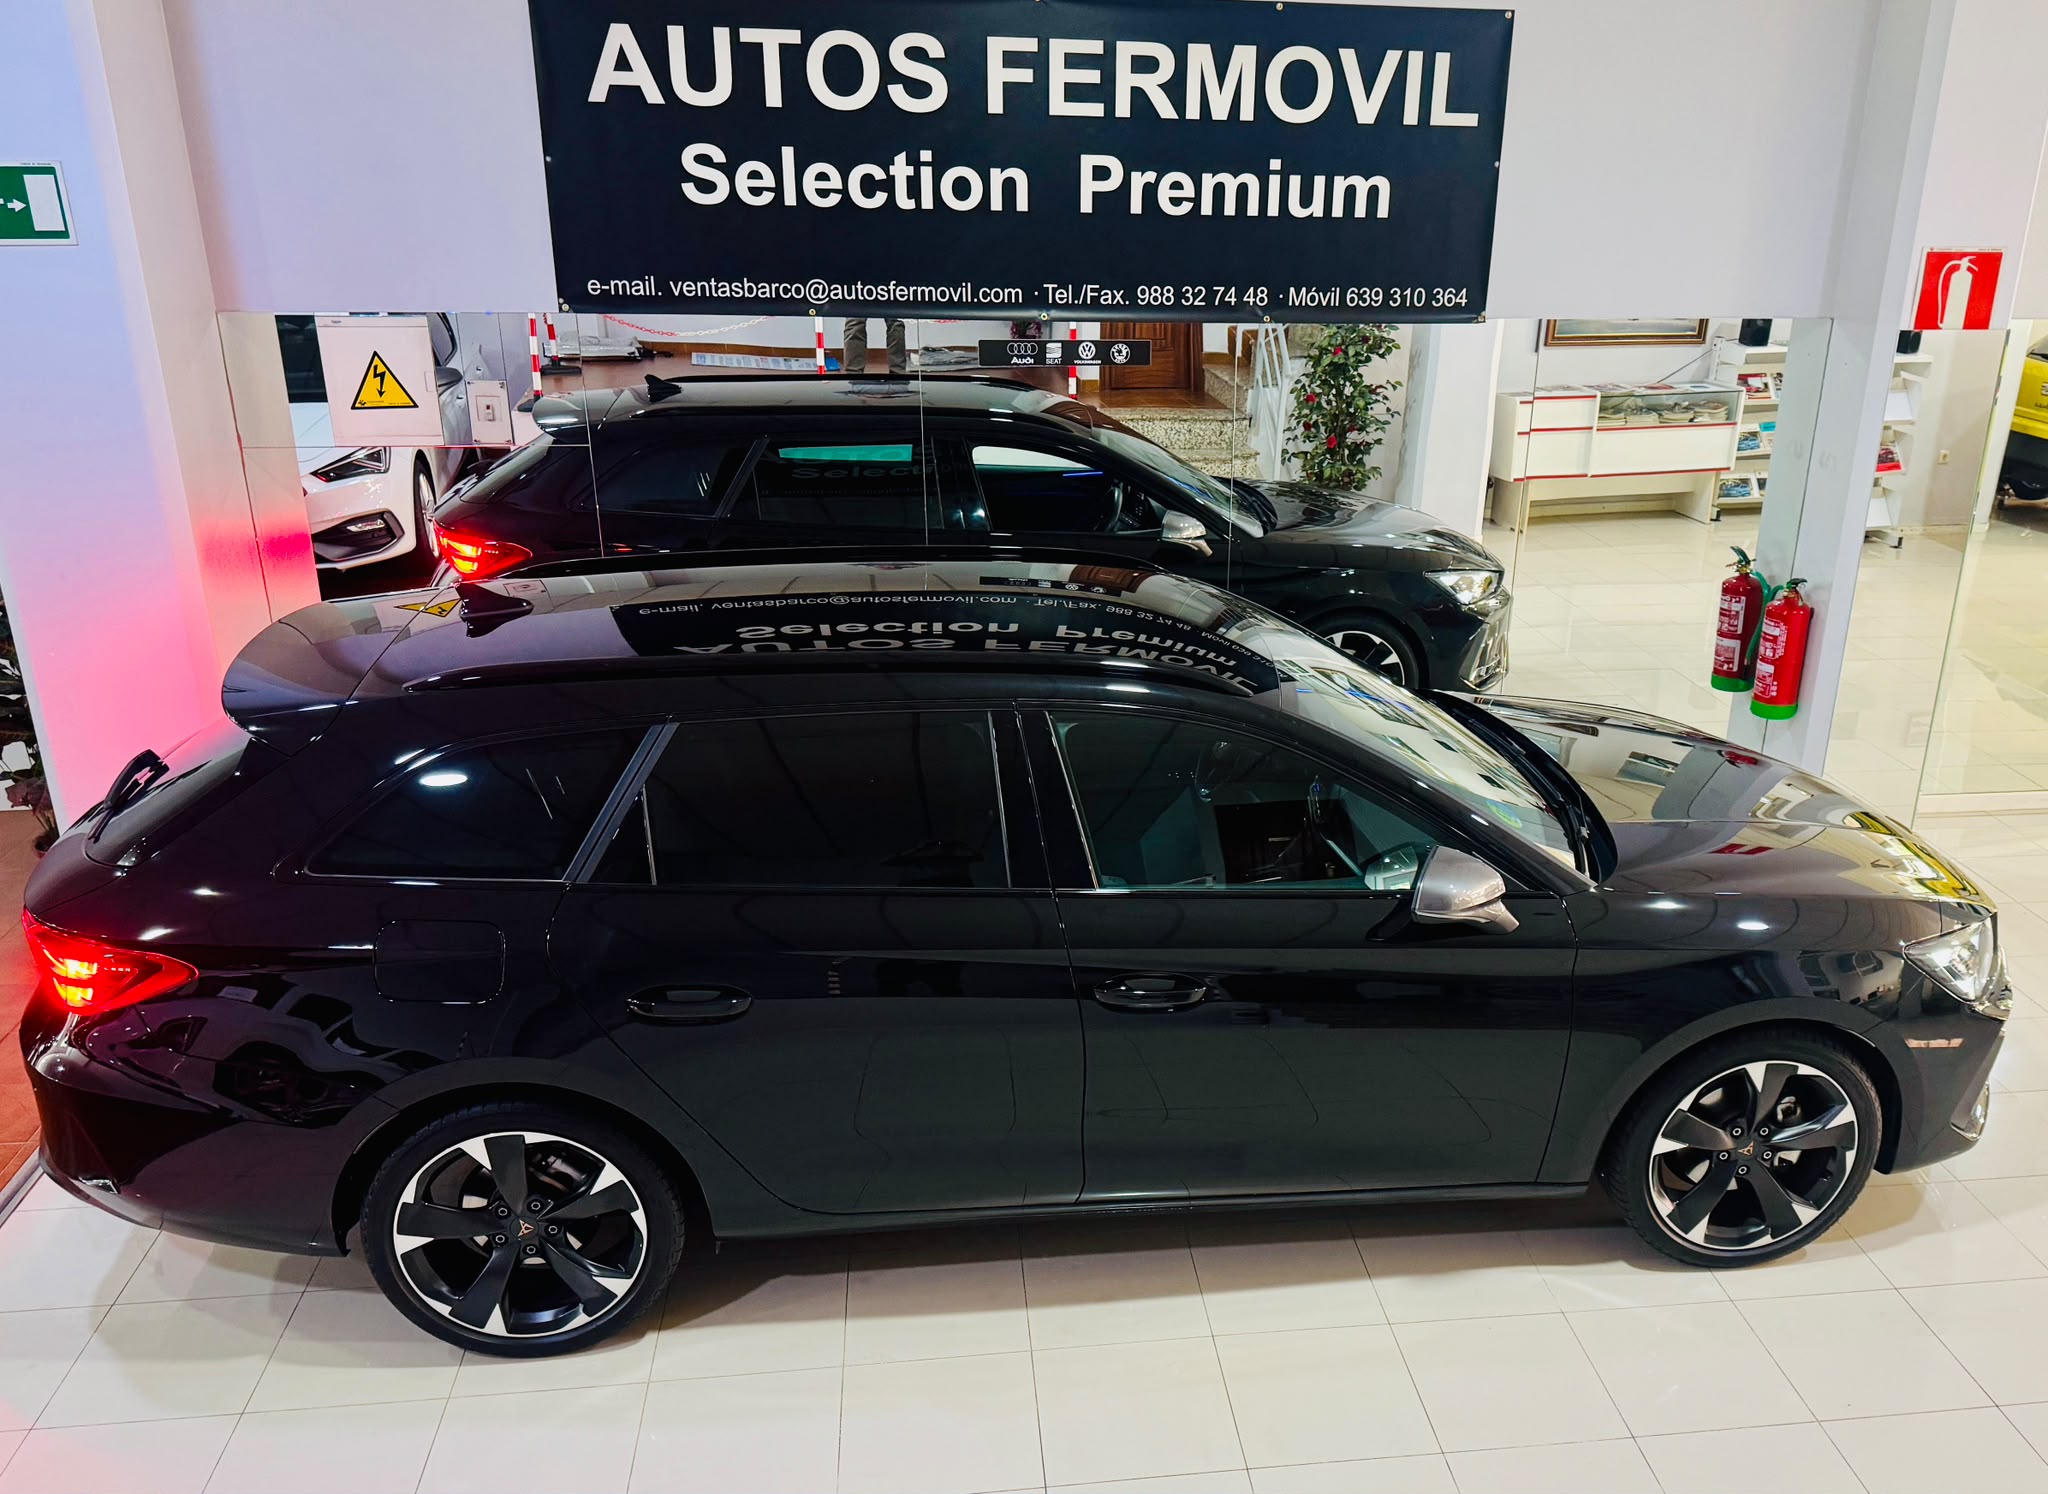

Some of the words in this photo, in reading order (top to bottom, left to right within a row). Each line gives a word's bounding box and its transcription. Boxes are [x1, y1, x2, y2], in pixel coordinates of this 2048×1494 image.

[588, 22, 949, 114] AUTOS
[986, 35, 1480, 128] FERMOVIL
[680, 142, 1030, 212] Selection
[1079, 154, 1391, 219] Premium
[587, 275, 662, 296] e-mail.
[669, 278, 1023, 306] ventasbarco@autosfermovil.com
[1136, 285, 1175, 306] 988
[1181, 286, 1206, 306] 32
[1212, 286, 1238, 306] 74
[1243, 286, 1268, 307] 48
[1288, 285, 1340, 308] Móvil
[1346, 287, 1383, 308] 639
[1389, 287, 1426, 308] 310
[1431, 287, 1468, 308] 364
[1010, 356, 1034, 365] Audi
